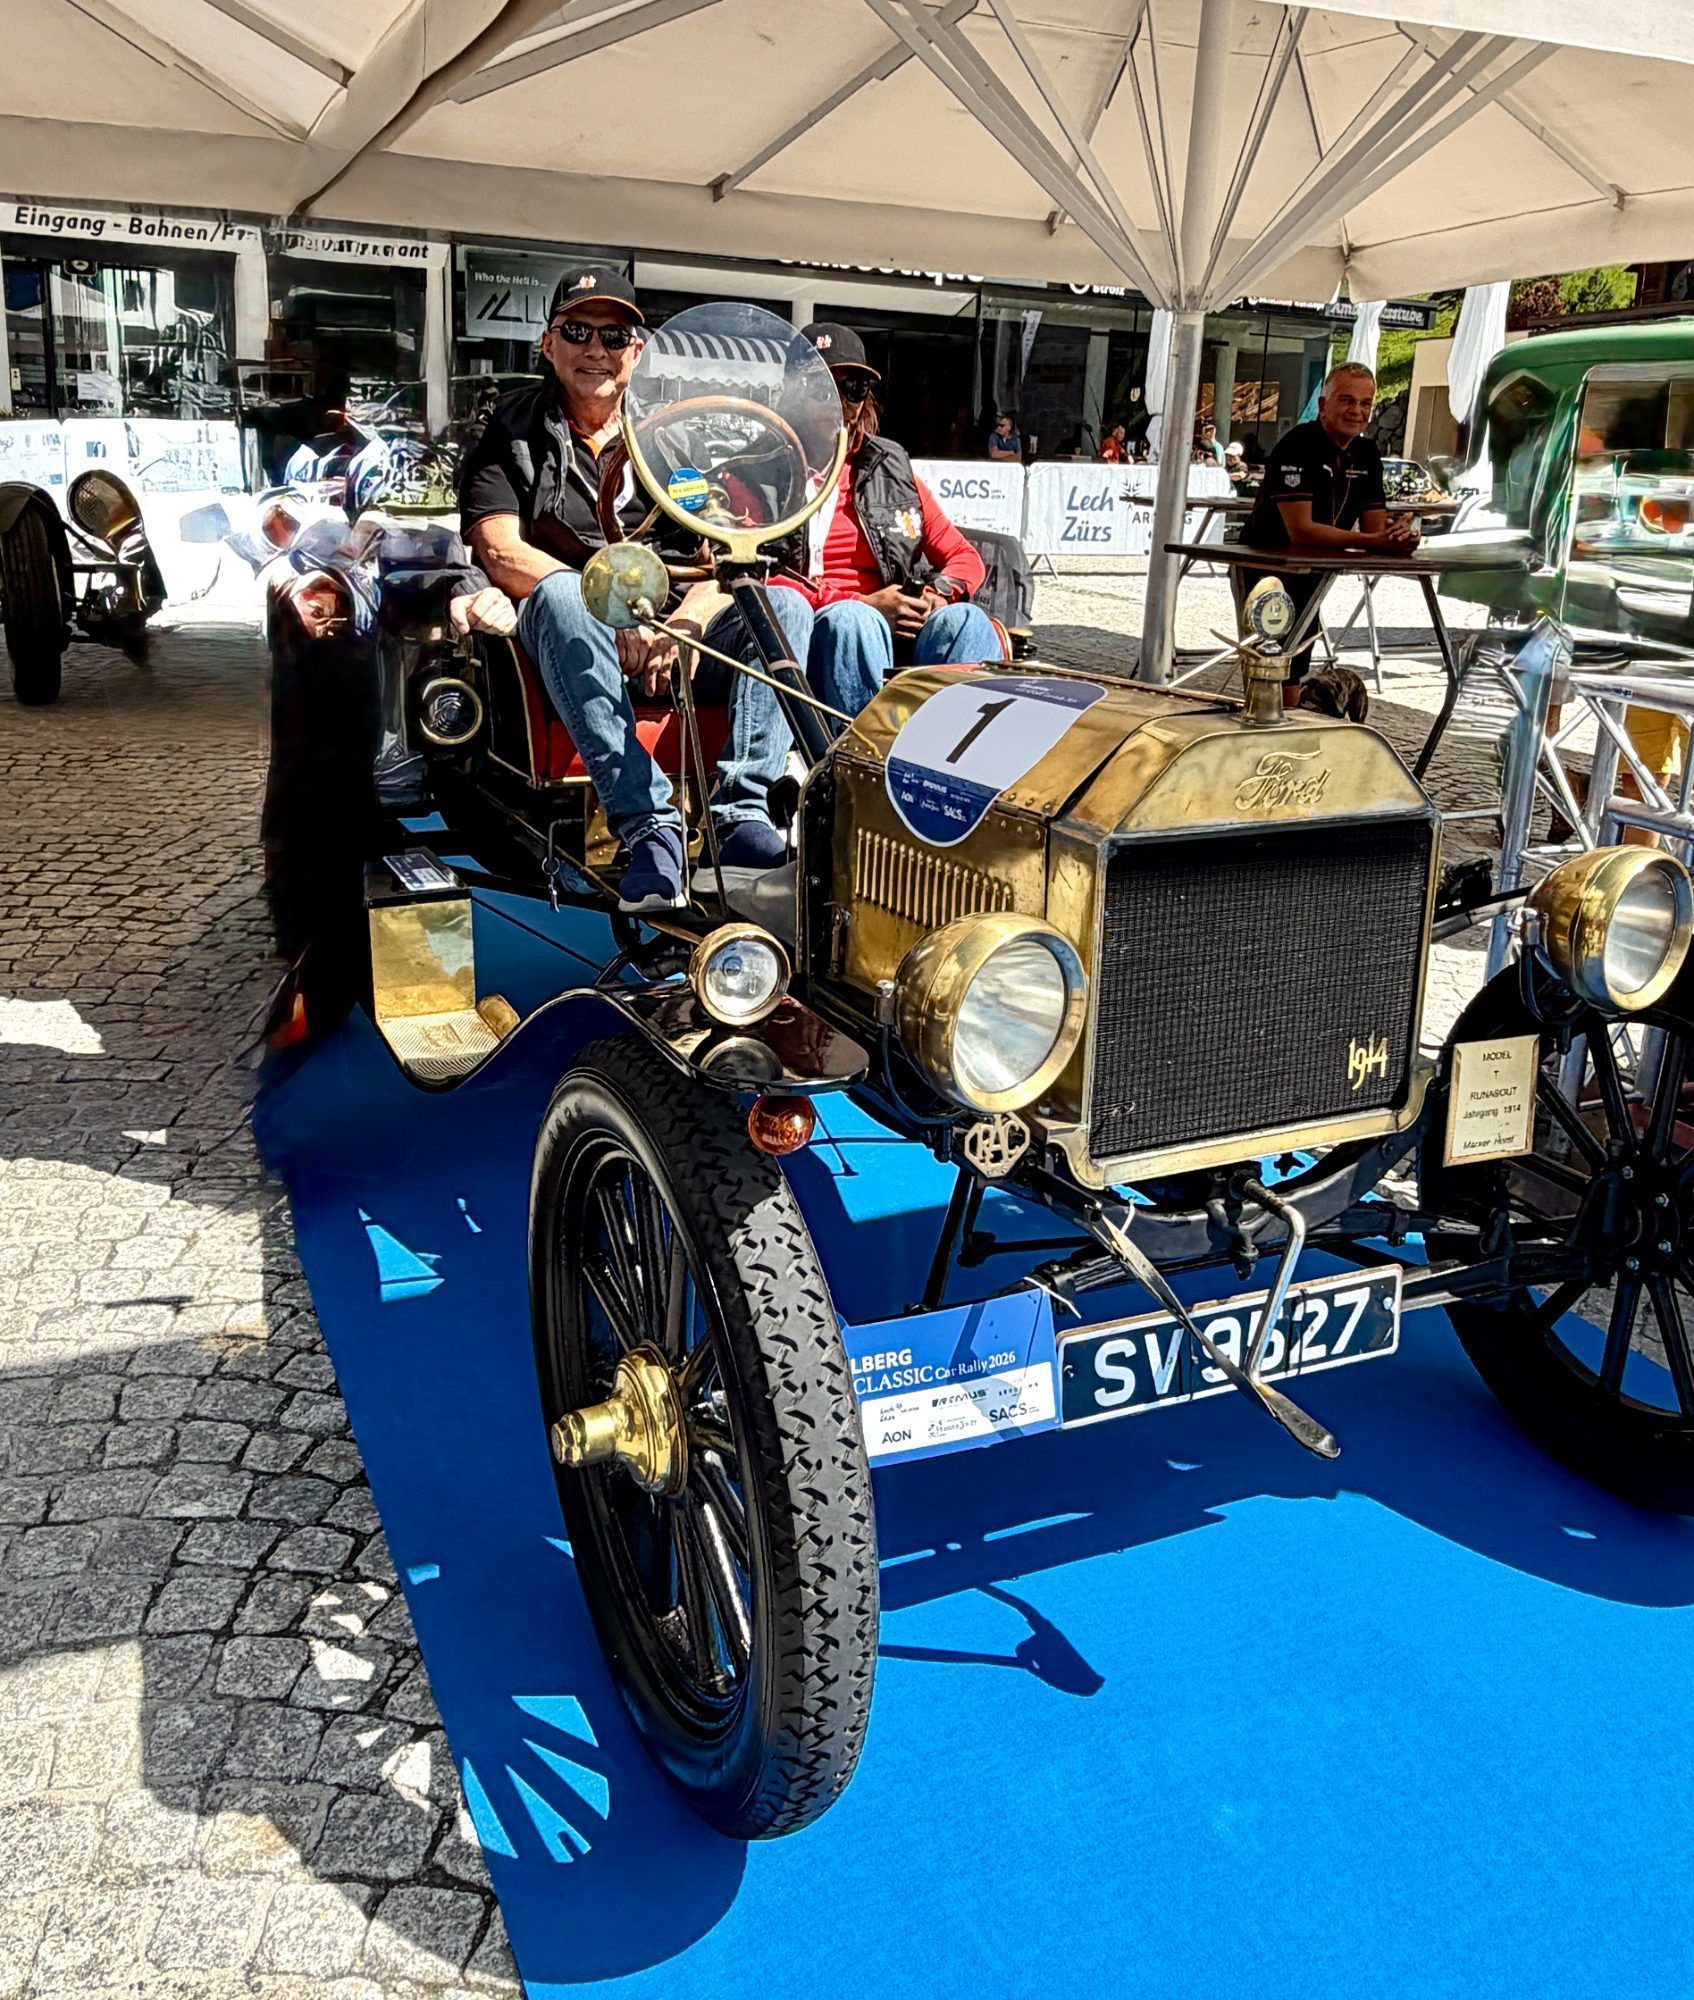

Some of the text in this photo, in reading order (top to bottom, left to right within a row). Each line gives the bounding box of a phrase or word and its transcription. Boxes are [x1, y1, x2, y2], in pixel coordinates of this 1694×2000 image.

[15, 206, 106, 236] Eingang
[939, 479, 990, 500] SACS
[1066, 485, 1114, 512] Lech
[1060, 515, 1113, 543] Zürs
[945, 697, 1018, 764] 1
[1234, 751, 1332, 811] Ford
[1347, 1030, 1389, 1090] 1914
[1482, 1050, 1512, 1062] MODEL
[1493, 1070, 1500, 1080] T
[851, 1348, 912, 1376] LBERG
[853, 1351, 1016, 1396] CLASSIC Car Rally 2026
[1094, 1328, 1184, 1407] SV
[989, 1402, 1028, 1423] SACS
[882, 1429, 912, 1444] AON
